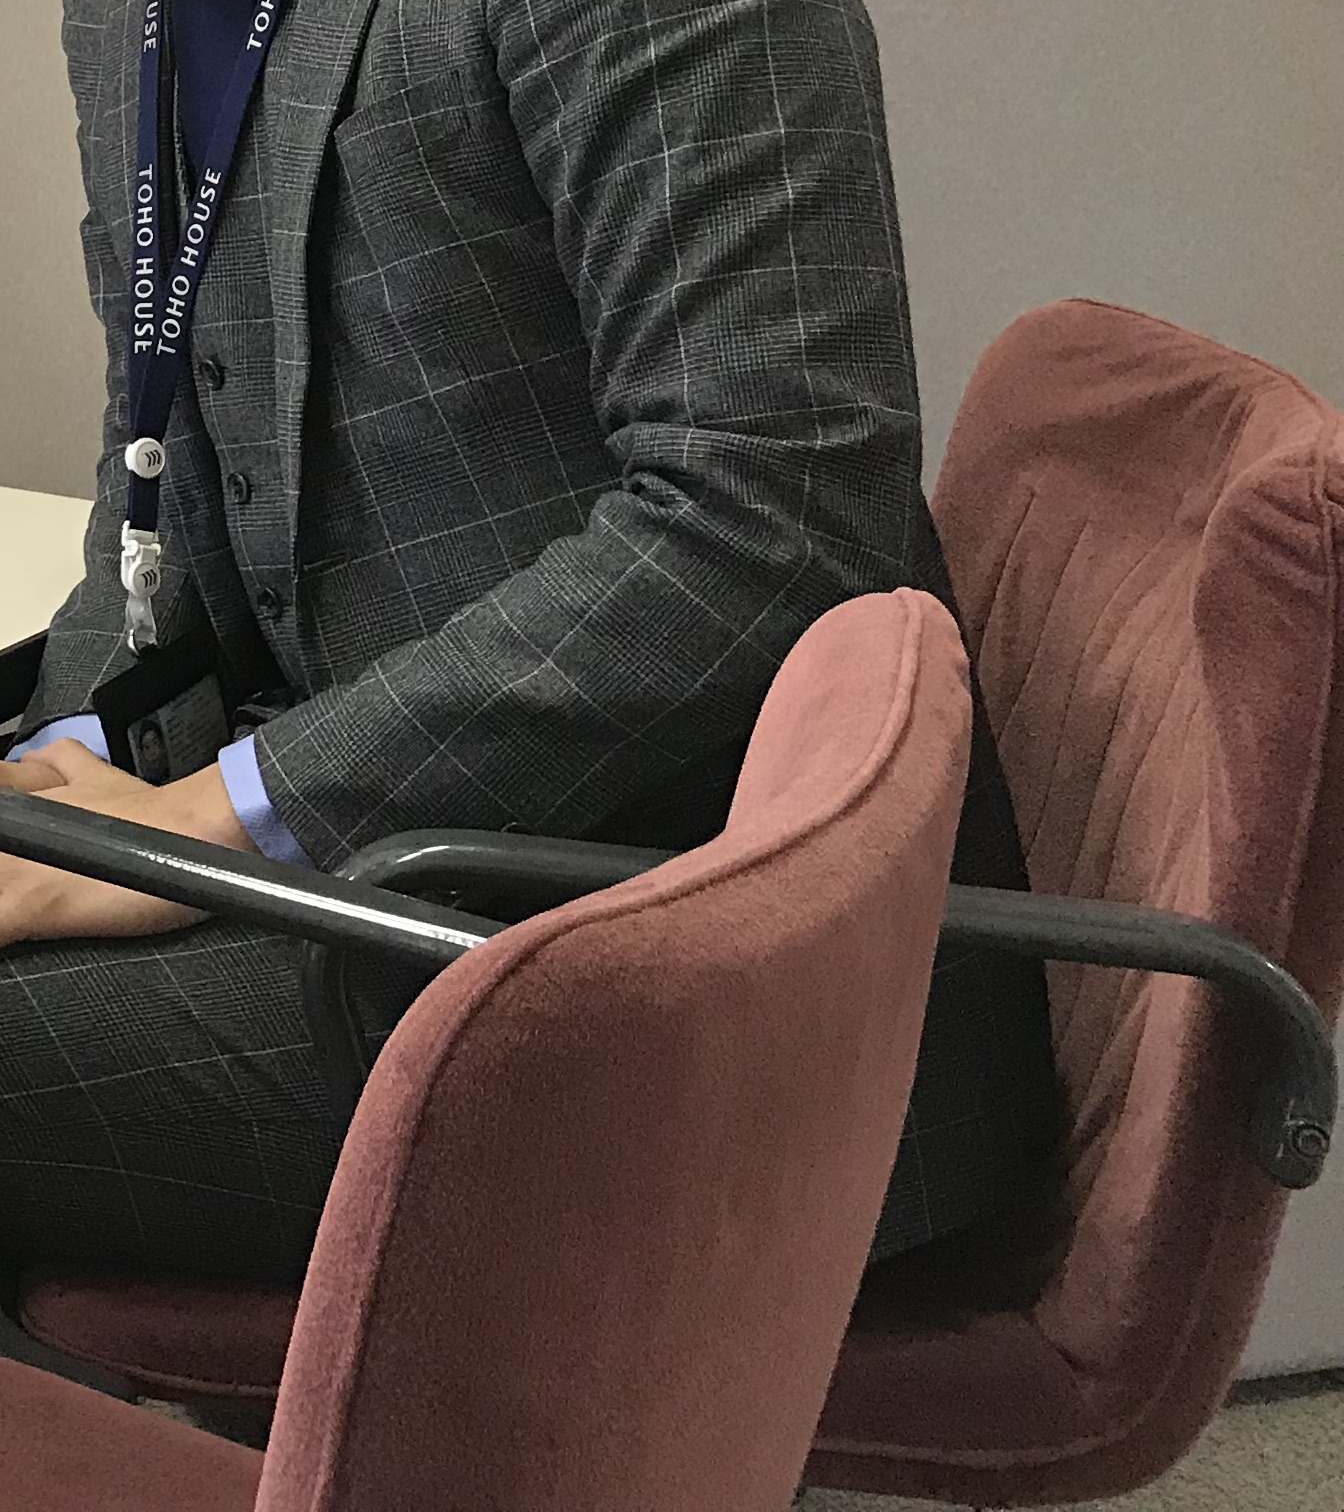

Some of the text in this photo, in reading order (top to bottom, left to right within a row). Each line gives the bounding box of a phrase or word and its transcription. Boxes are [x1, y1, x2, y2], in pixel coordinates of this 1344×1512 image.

[134, 164, 154, 355] TOHO HOUSE
[156, 166, 222, 357] TOHO HOUSE
